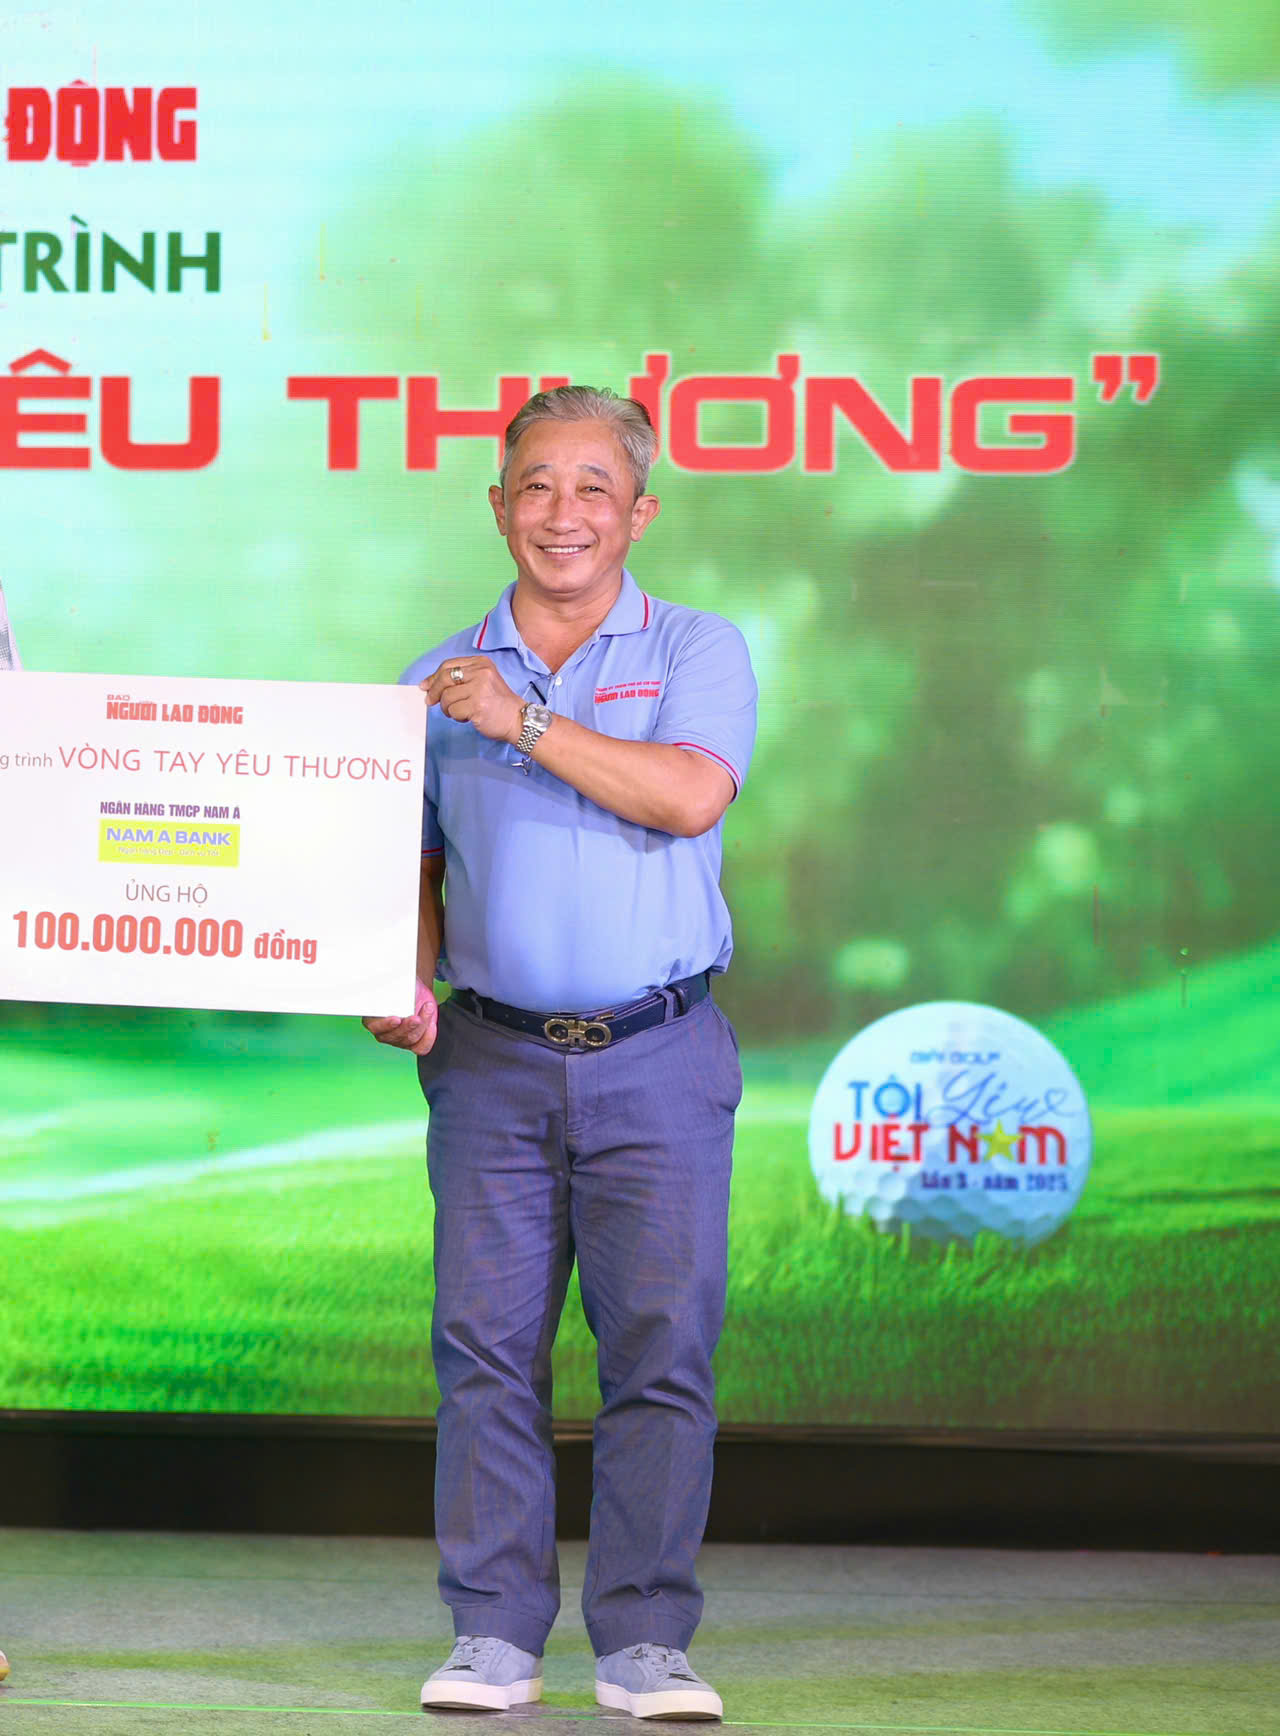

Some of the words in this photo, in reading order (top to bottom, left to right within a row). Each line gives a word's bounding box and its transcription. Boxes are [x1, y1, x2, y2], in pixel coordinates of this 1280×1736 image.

[7, 80, 197, 166] ĐỘNG
[162, 704, 193, 722] LAO
[15, 751, 53, 767] trình
[59, 742, 141, 771] VÒNG
[154, 751, 206, 774] TAY
[216, 748, 271, 776] YÊU
[284, 755, 412, 781] THƯƠNG
[100, 800, 131, 815] NGÂN
[134, 801, 165, 816] HÀNG
[169, 804, 200, 818] TMCP
[204, 806, 229, 819] NAM
[106, 828, 153, 842] NAM
[157, 830, 171, 844] A
[175, 831, 231, 845] BANK
[125, 879, 170, 902] ỦNG
[177, 884, 208, 908] HỘ
[13, 910, 243, 958] 100.000.000
[254, 929, 318, 964] đồng
[848, 1074, 922, 1120] TÔI
